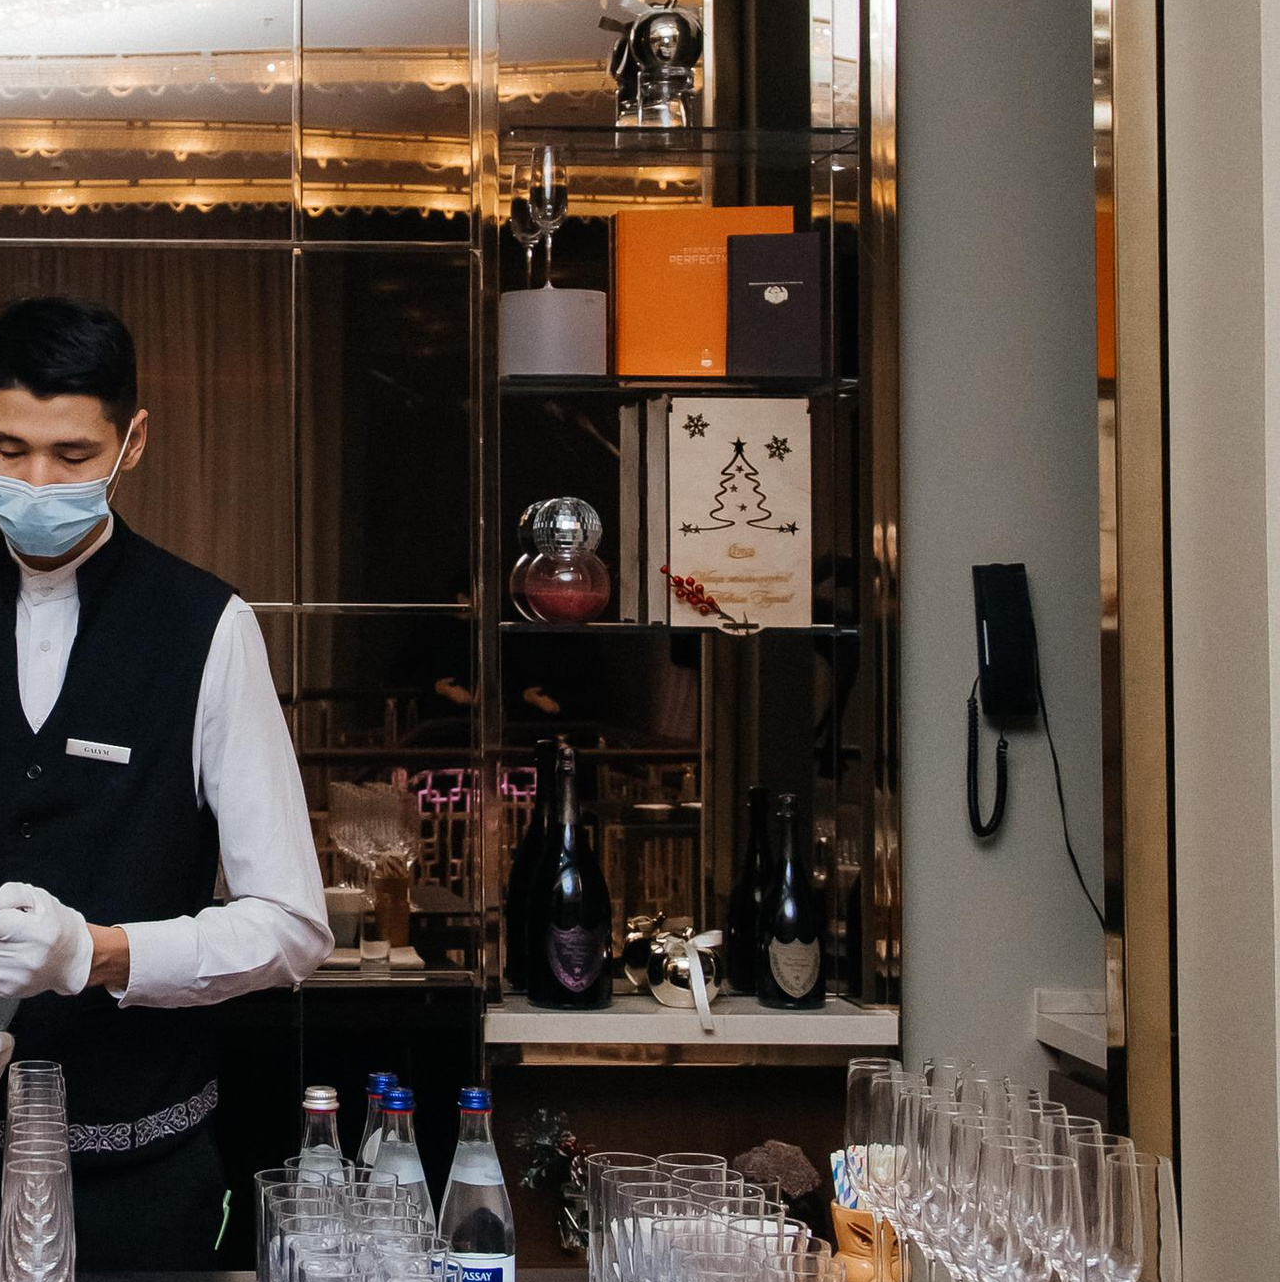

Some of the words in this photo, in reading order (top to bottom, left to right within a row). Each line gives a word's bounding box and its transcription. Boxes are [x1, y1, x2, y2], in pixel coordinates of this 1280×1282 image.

[669, 254, 727, 265] PERFECTI
[84, 747, 110, 756] GALYM
[461, 1271, 492, 1282] ASSAY
